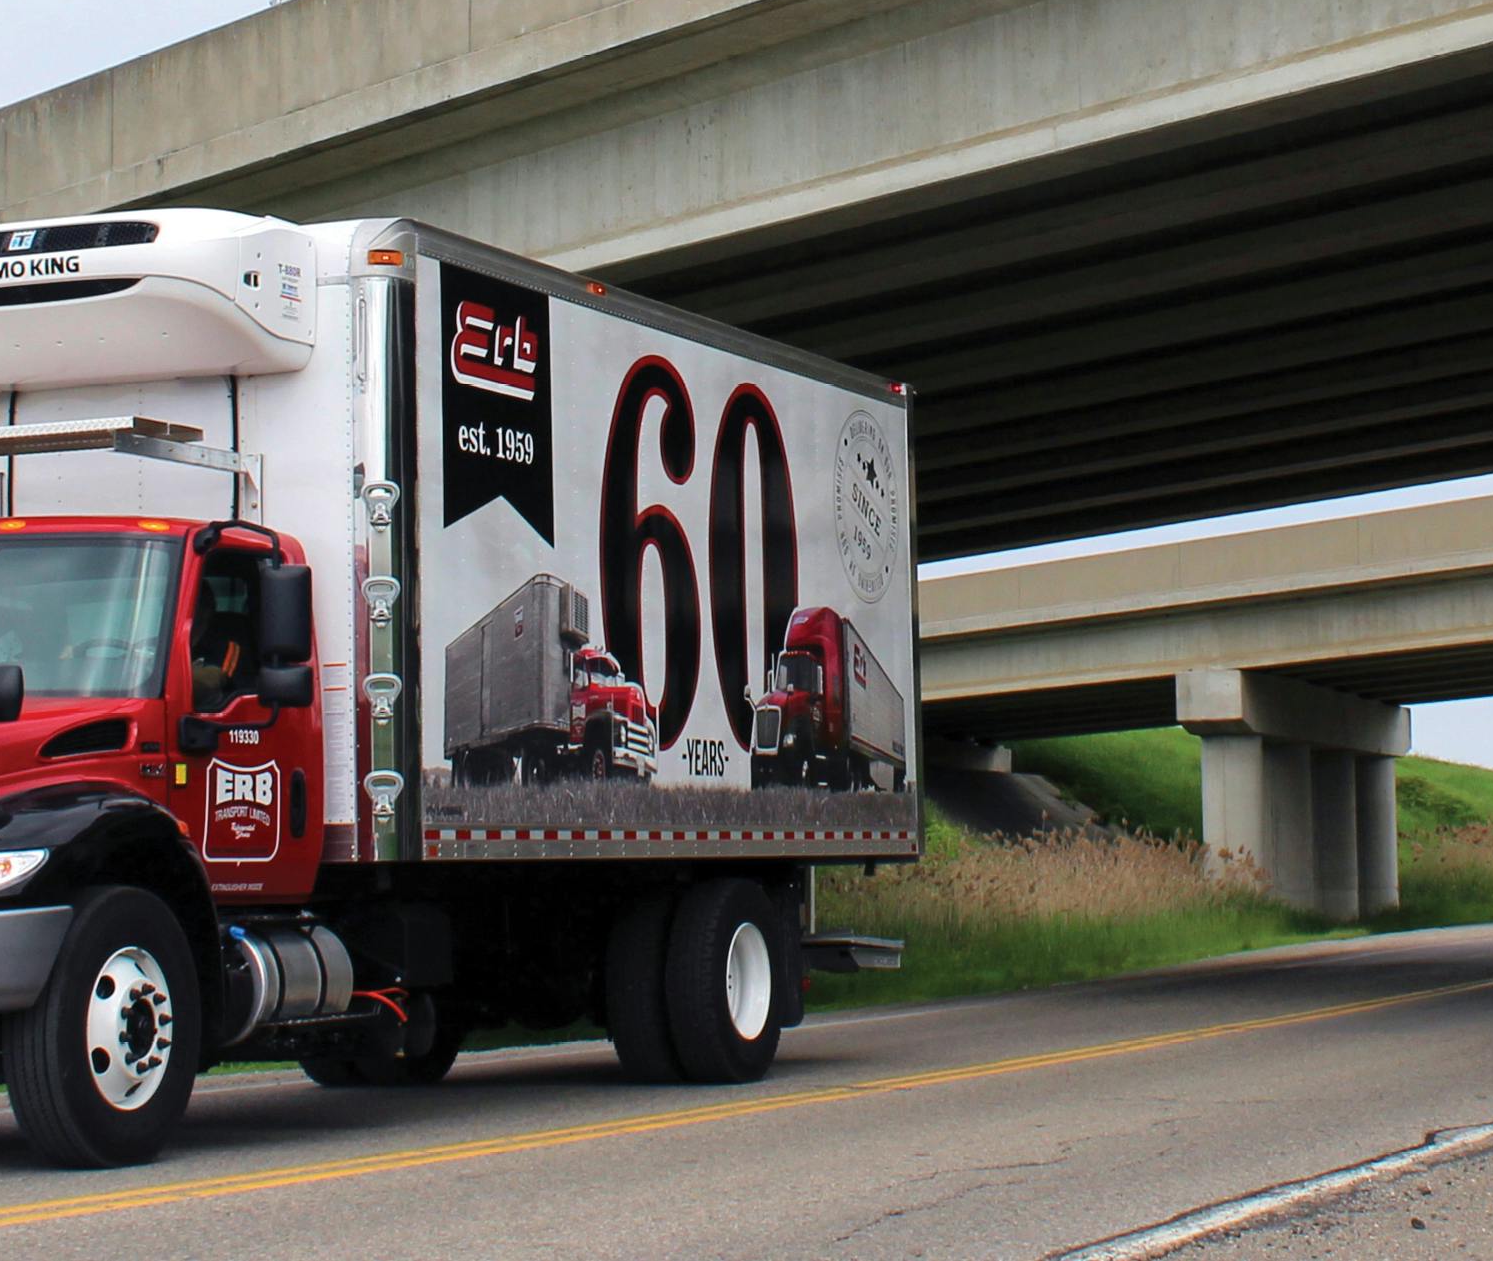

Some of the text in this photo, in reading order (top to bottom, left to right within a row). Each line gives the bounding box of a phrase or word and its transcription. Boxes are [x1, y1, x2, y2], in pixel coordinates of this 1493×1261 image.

[30, 255, 80, 276] KING
[450, 300, 539, 401] Erb
[458, 421, 534, 465] est. 1959
[851, 483, 882, 537] SINCE
[600, 354, 799, 751] 60
[854, 525, 872, 561] 1959
[229, 729, 259, 744] 119330
[216, 767, 273, 806] ERB
[215, 806, 271, 826] TRANSPORT LIMITED
